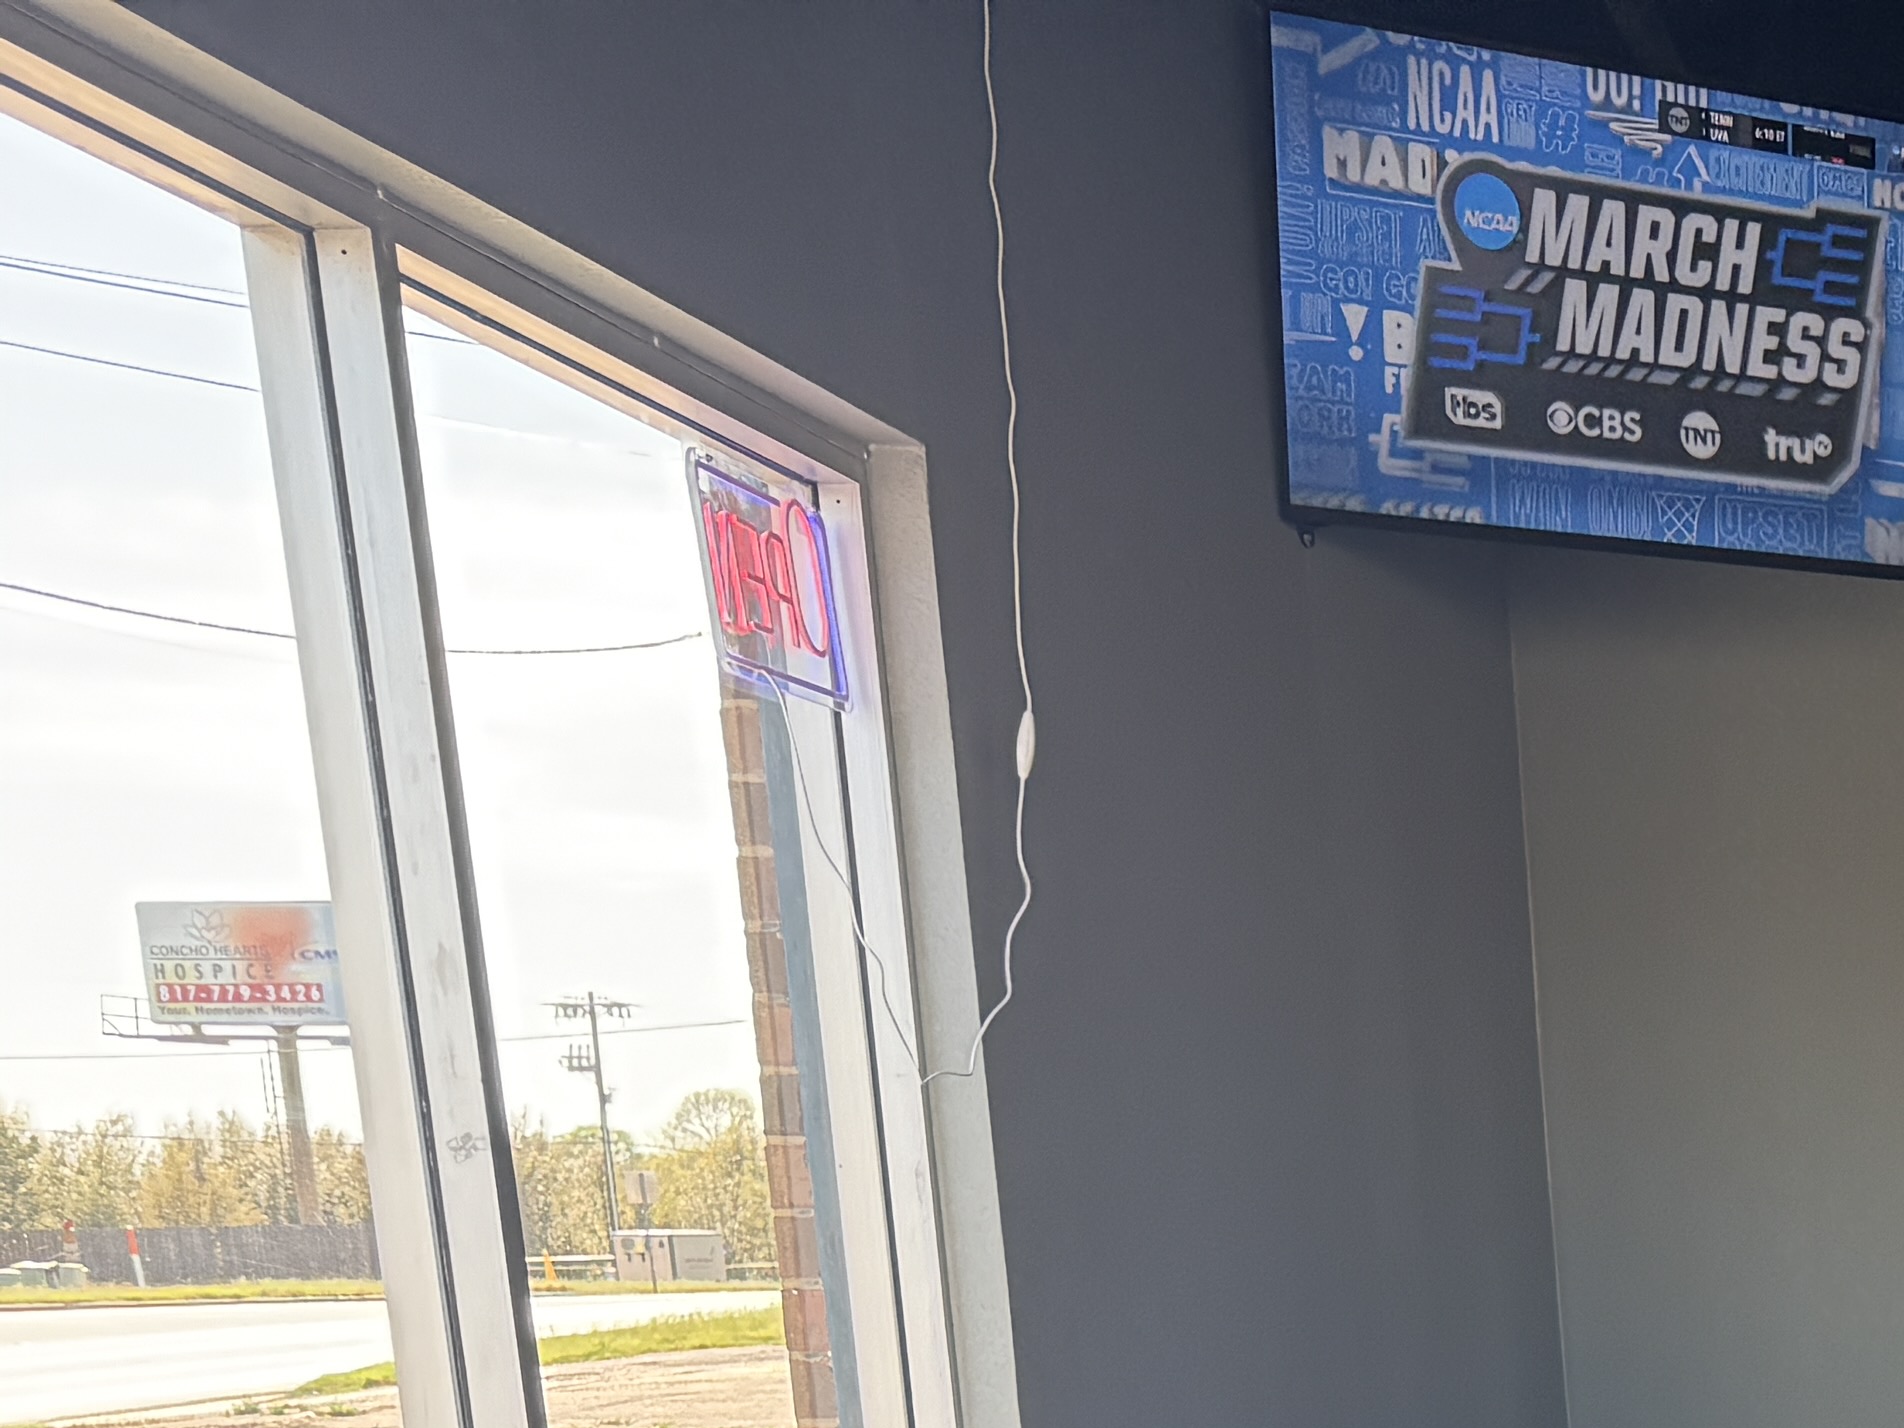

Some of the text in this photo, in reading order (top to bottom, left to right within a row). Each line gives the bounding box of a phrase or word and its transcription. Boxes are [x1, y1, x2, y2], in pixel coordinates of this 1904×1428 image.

[1407, 54, 1499, 143] NCAA
[1669, 114, 1690, 126] TNT
[1463, 208, 1518, 234] NCAA
[1525, 187, 1763, 295] MARCH
[1555, 277, 1866, 390] MADNESS
[1449, 393, 1498, 422] tbs
[1577, 405, 1644, 442] CBS
[1682, 424, 1721, 449] TNT
[150, 944, 210, 957] CONCHO
[154, 962, 276, 980] HOSPICE
[159, 984, 321, 1001] 817-779-3426
